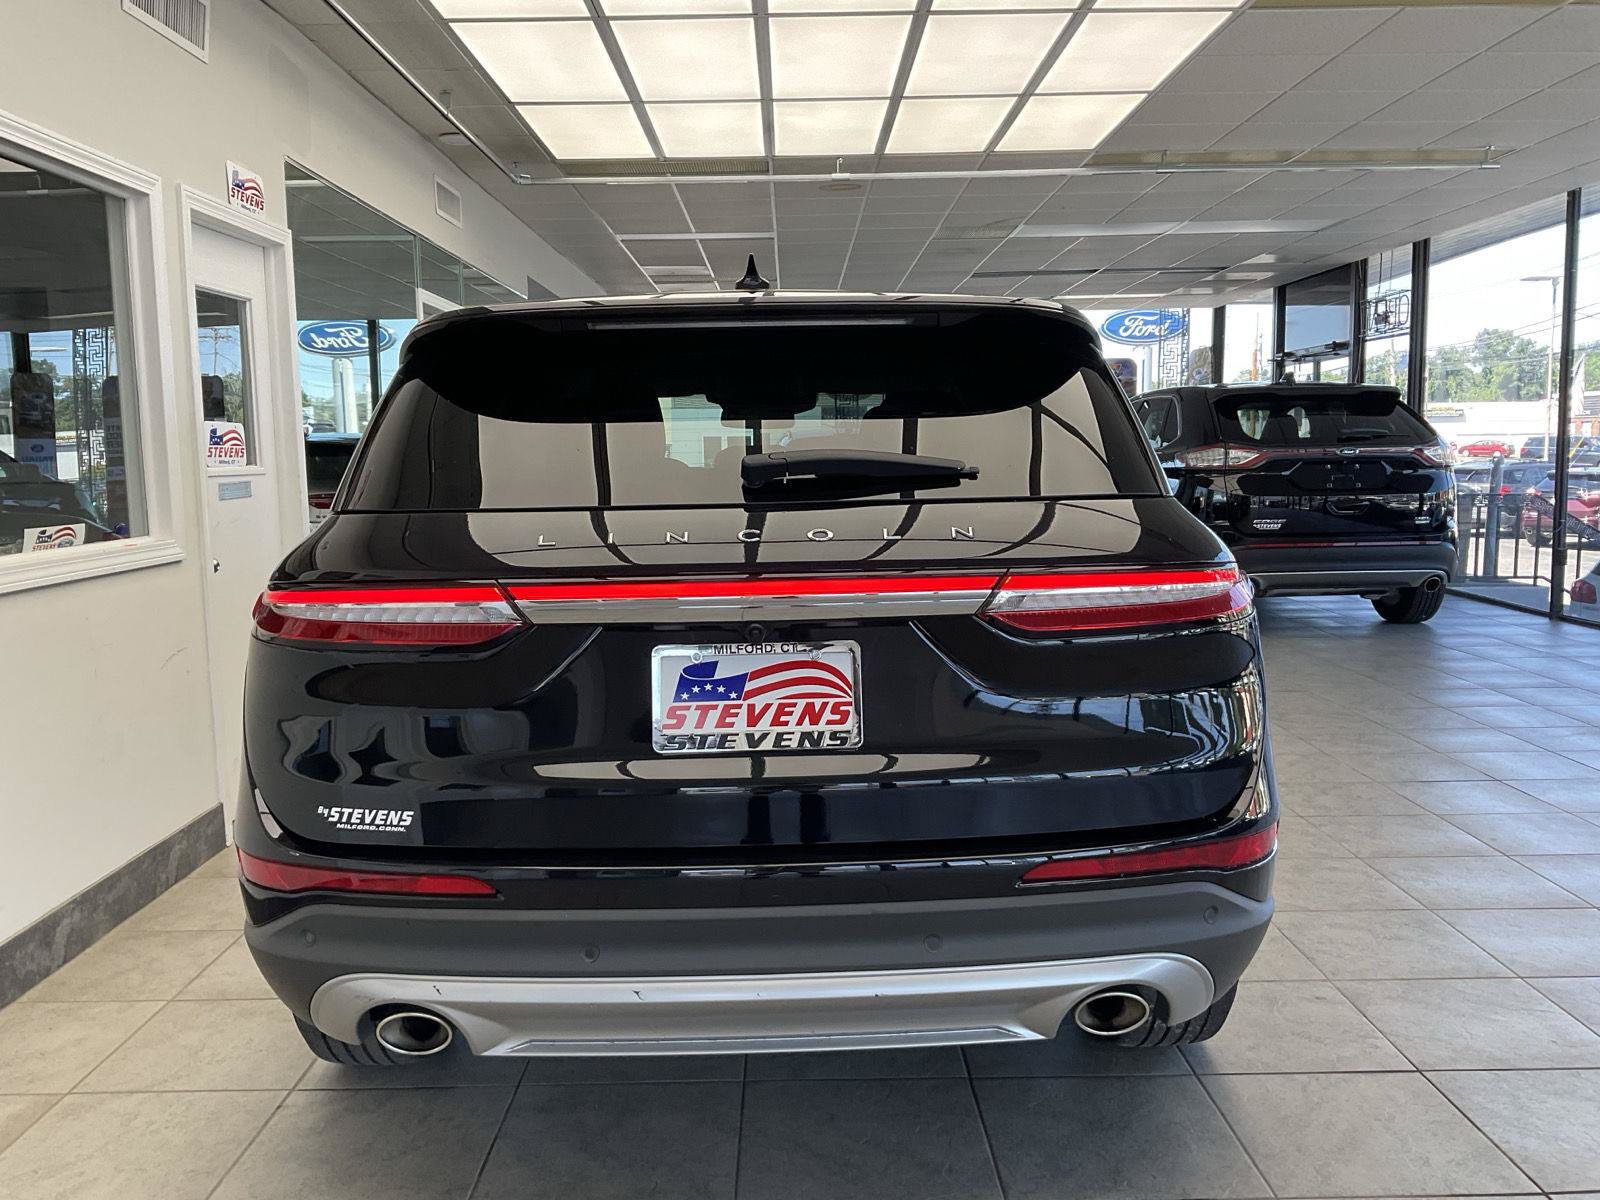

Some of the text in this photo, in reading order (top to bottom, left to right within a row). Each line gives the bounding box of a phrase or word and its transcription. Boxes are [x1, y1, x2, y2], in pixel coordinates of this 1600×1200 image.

[231, 187, 264, 210] STEVENS
[1119, 315, 1171, 337] Ford
[207, 447, 245, 458] STEVENS
[537, 525, 976, 548] LINCOLN
[31, 543, 56, 552] STEVENS
[780, 642, 799, 653] CT
[661, 701, 853, 730] STEVENS
[662, 731, 851, 751] STEVENS
[328, 807, 414, 826] STEVENS
